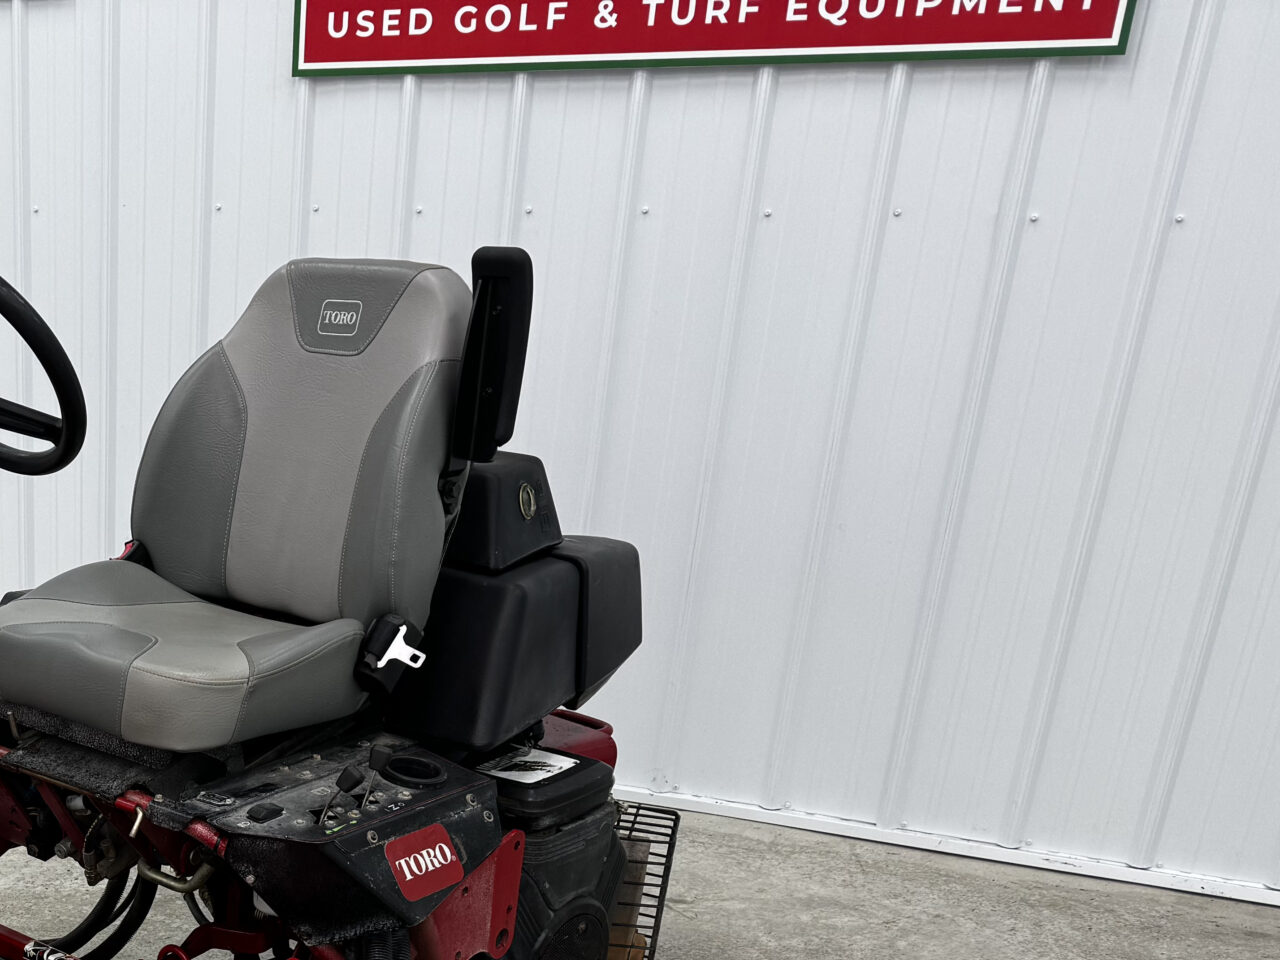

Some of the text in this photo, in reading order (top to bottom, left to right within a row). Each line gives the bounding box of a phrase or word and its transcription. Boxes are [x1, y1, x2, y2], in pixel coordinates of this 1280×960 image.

[327, 8, 433, 38] USED
[454, 1, 568, 34] GOLF
[593, 0, 618, 28] &
[642, 0, 760, 26] TURF
[323, 310, 357, 325] TORO
[395, 843, 452, 881] TORO
